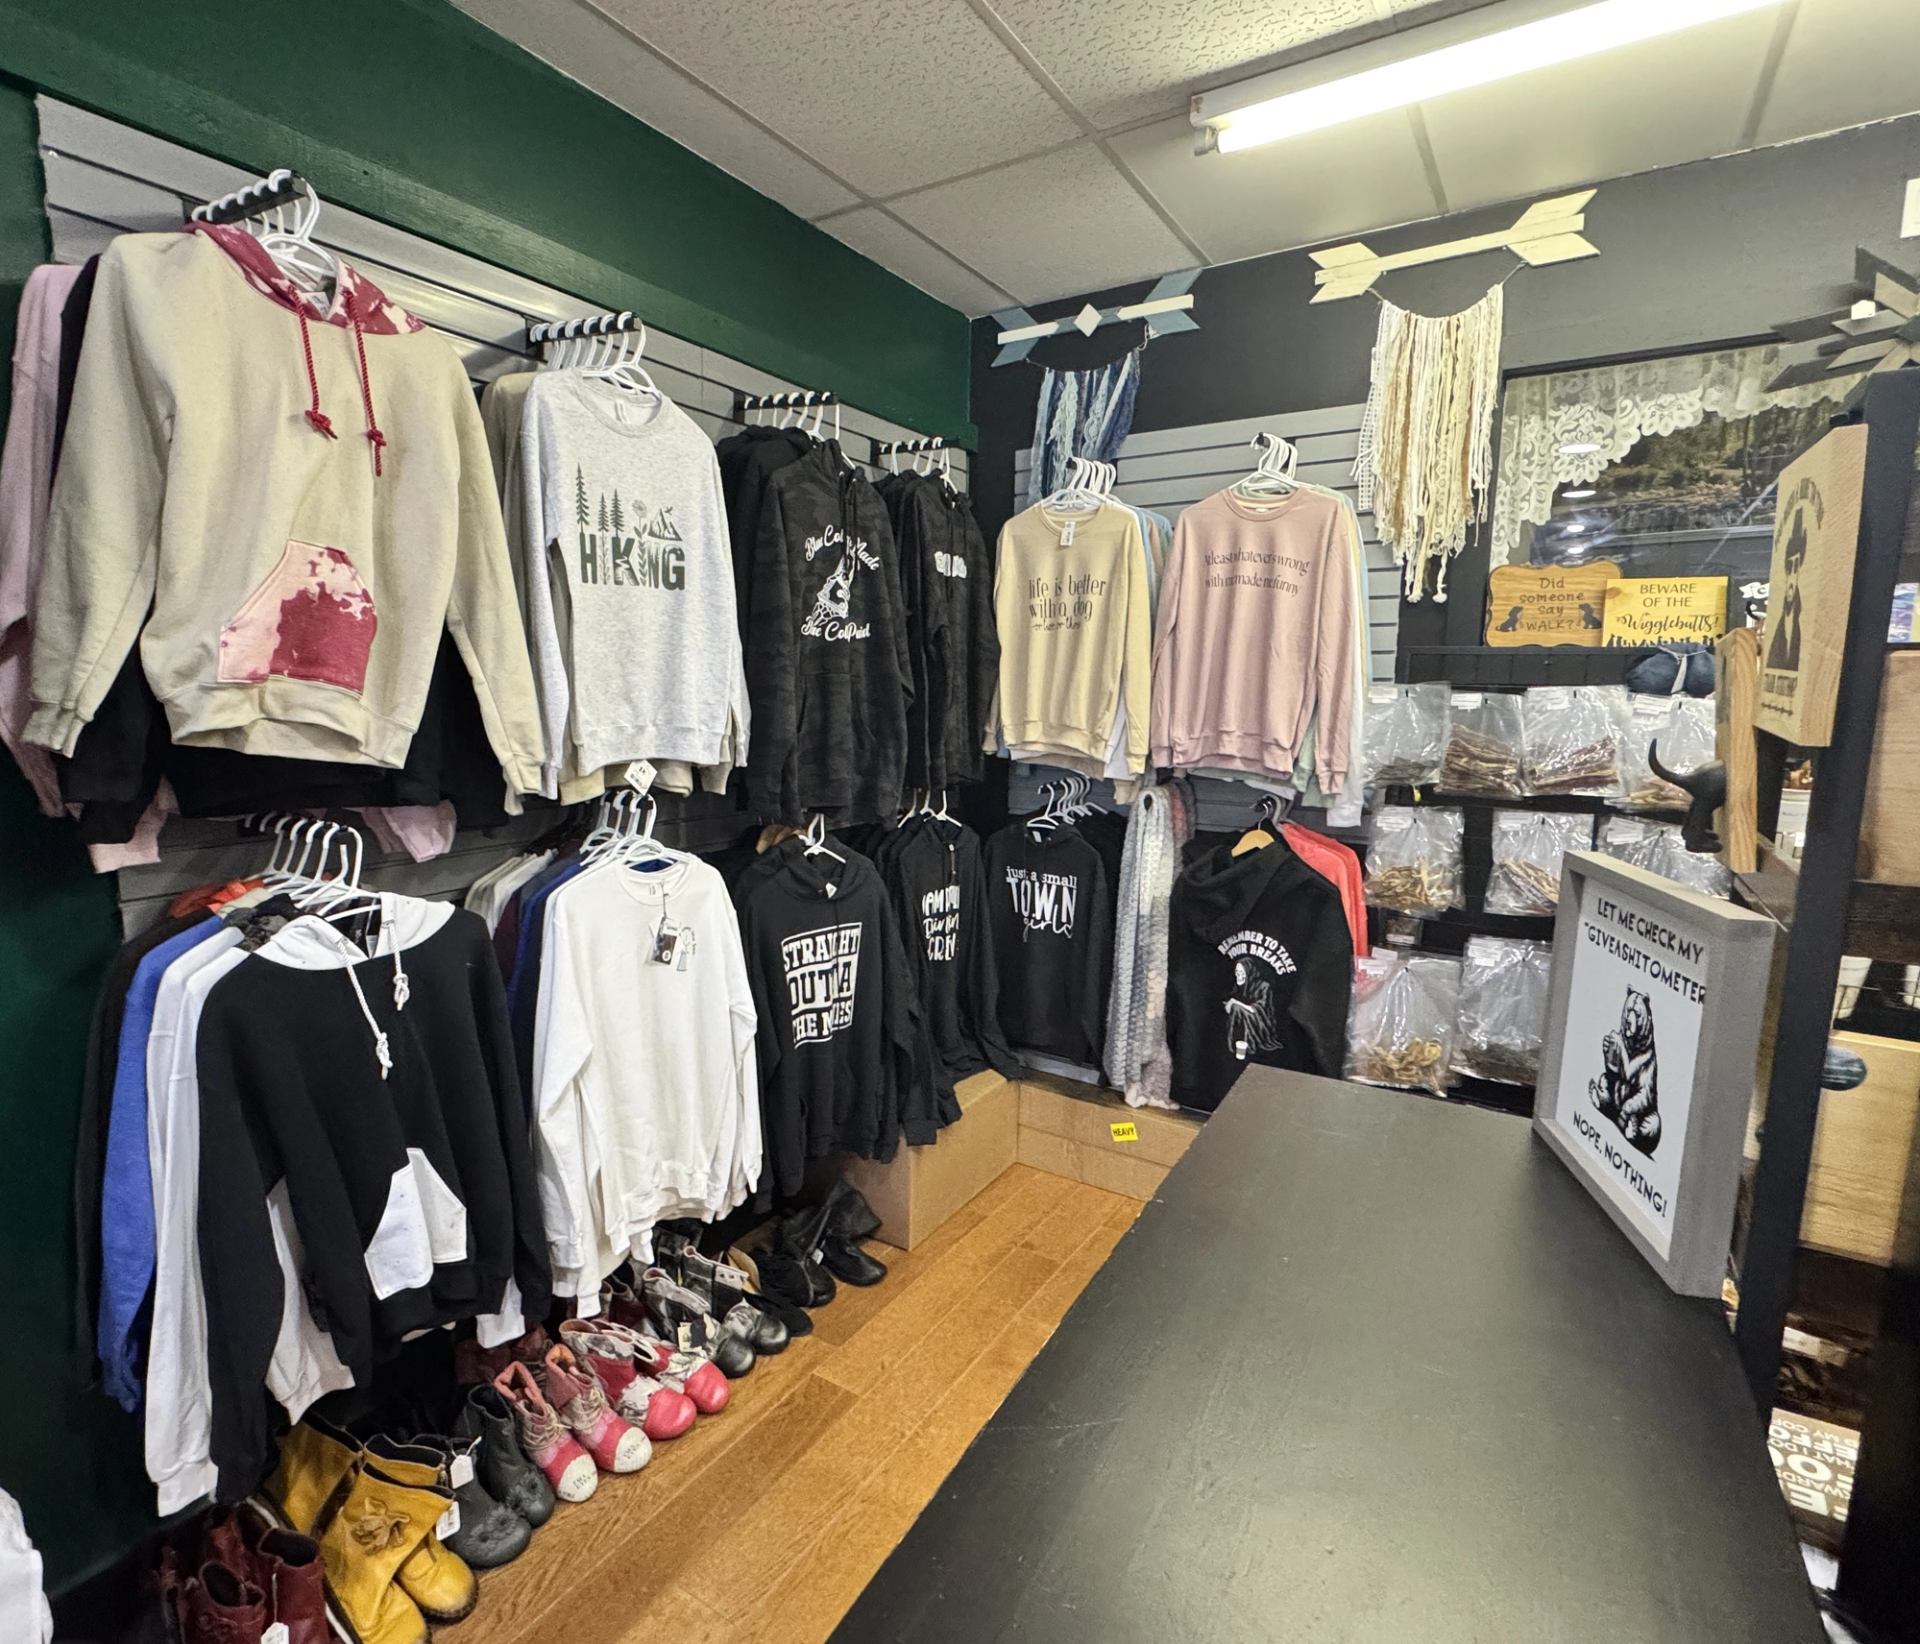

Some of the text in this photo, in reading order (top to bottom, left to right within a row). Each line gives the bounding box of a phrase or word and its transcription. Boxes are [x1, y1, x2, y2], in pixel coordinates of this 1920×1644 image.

[579, 532, 685, 591] HIKING
[1539, 576, 1565, 589] Did
[1029, 574, 1106, 599] life is better
[1640, 583, 1697, 594] BEWARE
[1642, 596, 1693, 608] OF THE
[1006, 877, 1077, 925] TOWN
[1031, 871, 1038, 881] a
[1041, 873, 1077, 888] small
[782, 928, 861, 972] STRAHT
[1217, 930, 1297, 974] REMEMBER TO TAKE
[1597, 897, 1704, 965] LET ME CHECK MY
[1227, 943, 1287, 976] YOUR BREAKS
[788, 961, 852, 1011] OUTA
[1604, 1141, 1668, 1218] NOTHING!
